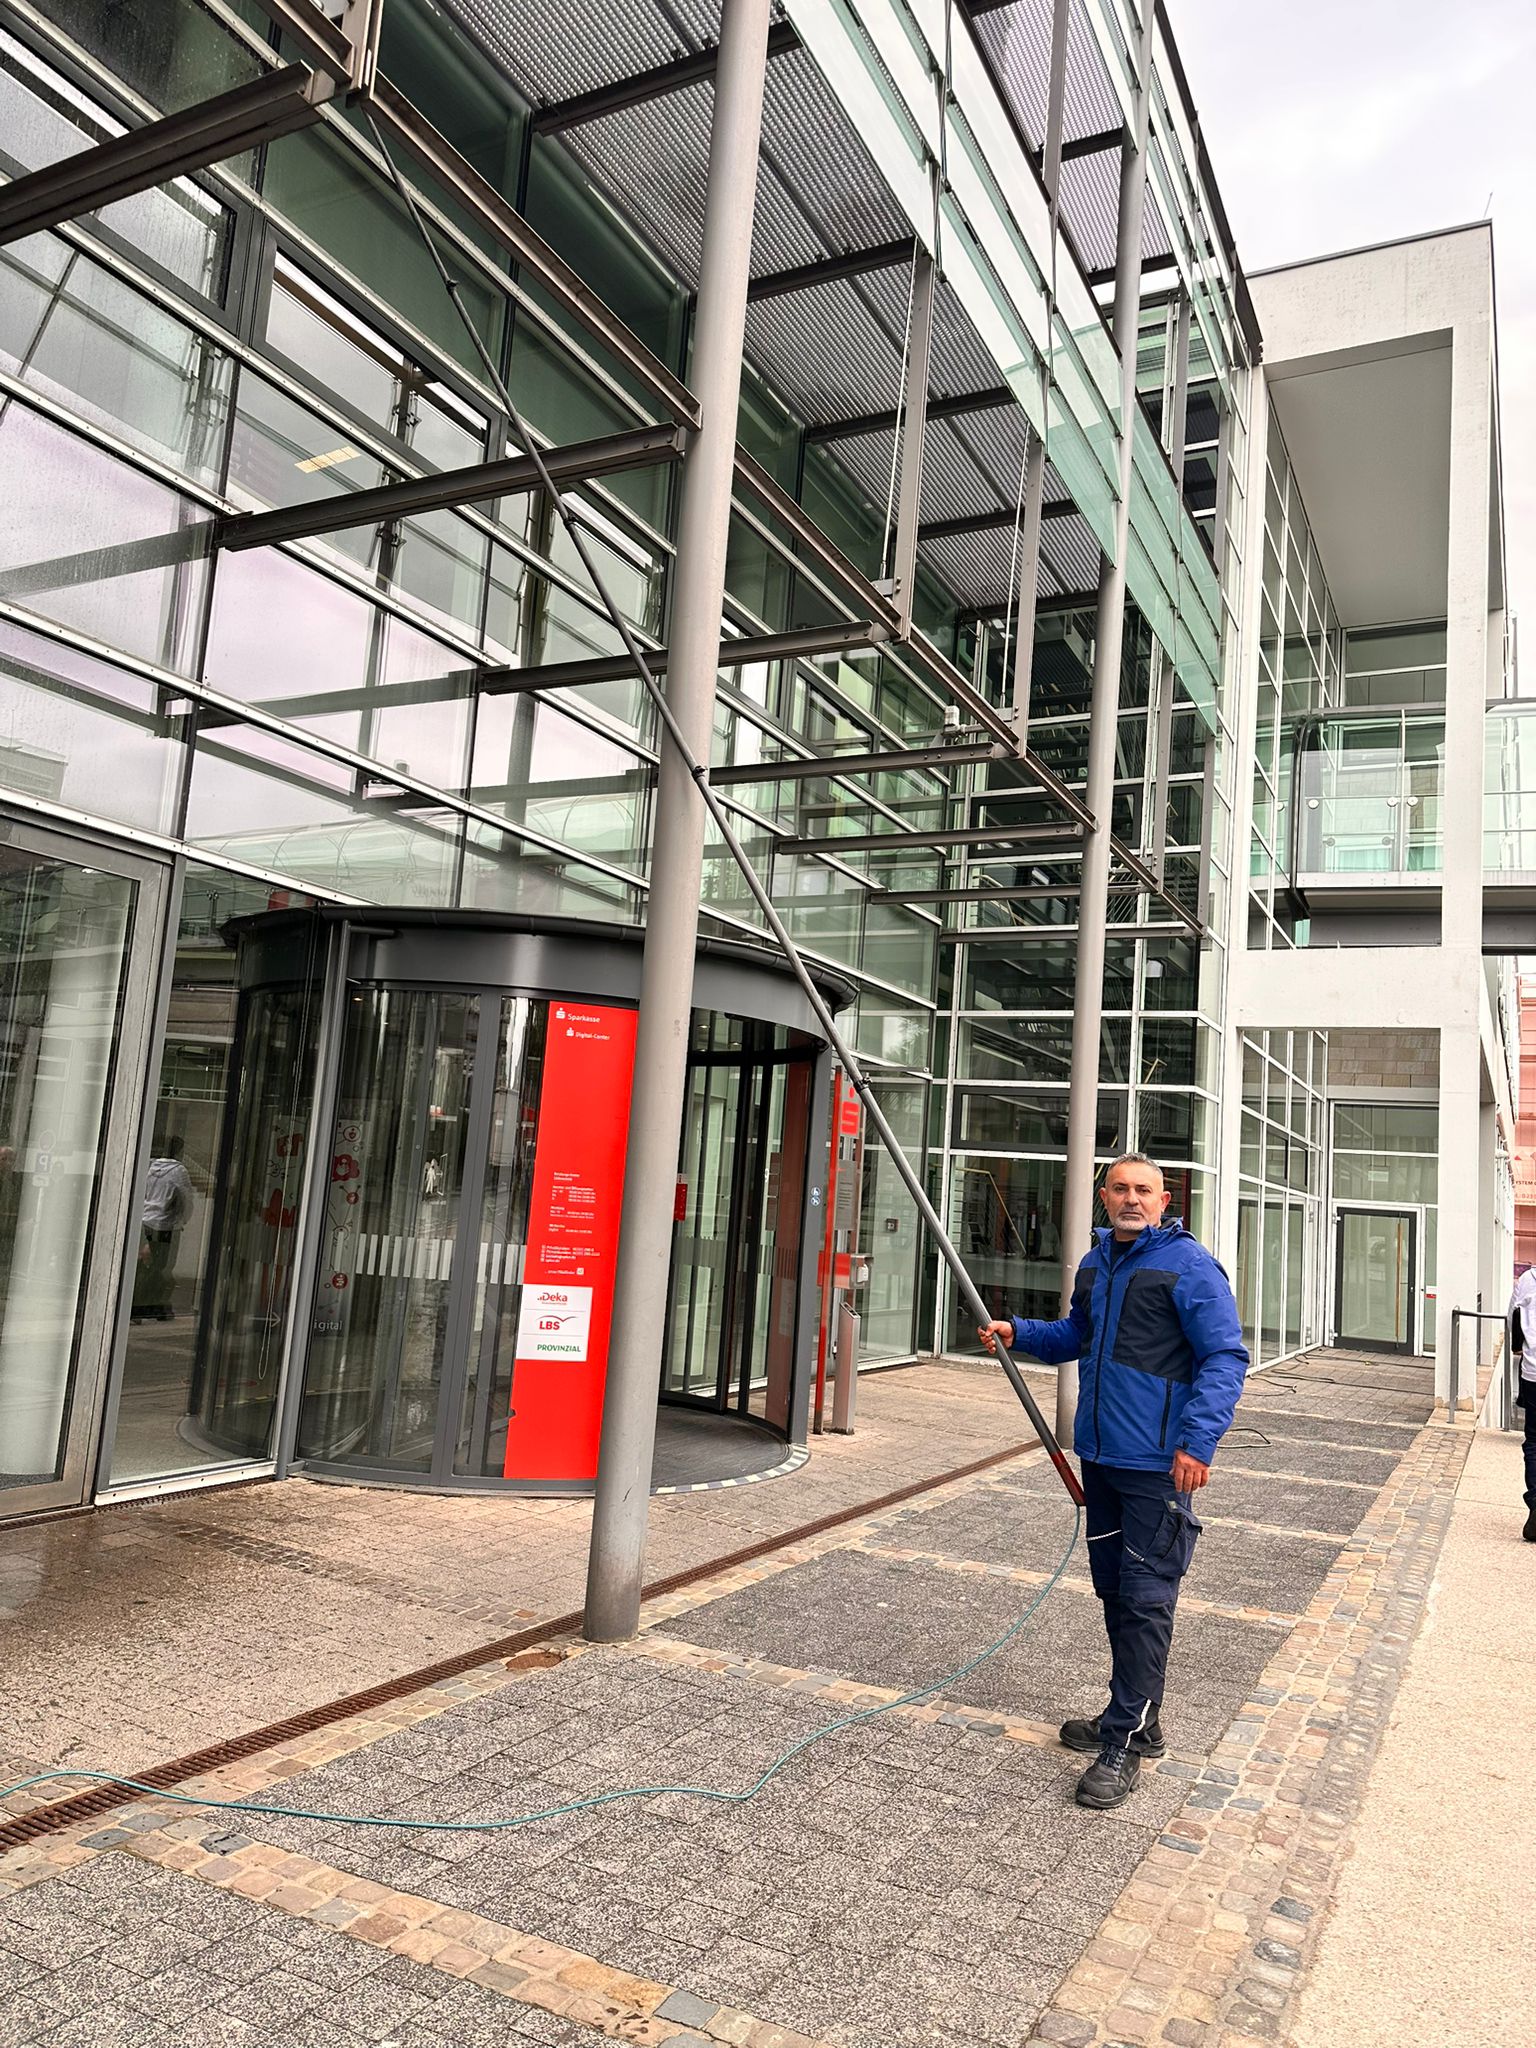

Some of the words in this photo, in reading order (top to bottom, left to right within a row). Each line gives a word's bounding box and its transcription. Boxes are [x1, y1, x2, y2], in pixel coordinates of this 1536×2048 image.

[567, 1013, 601, 1023] Sparkasse
[541, 1292, 568, 1302] Deka
[313, 1319, 343, 1332] igital
[539, 1320, 560, 1331] LBS
[536, 1344, 581, 1353] PROVINZIAL
